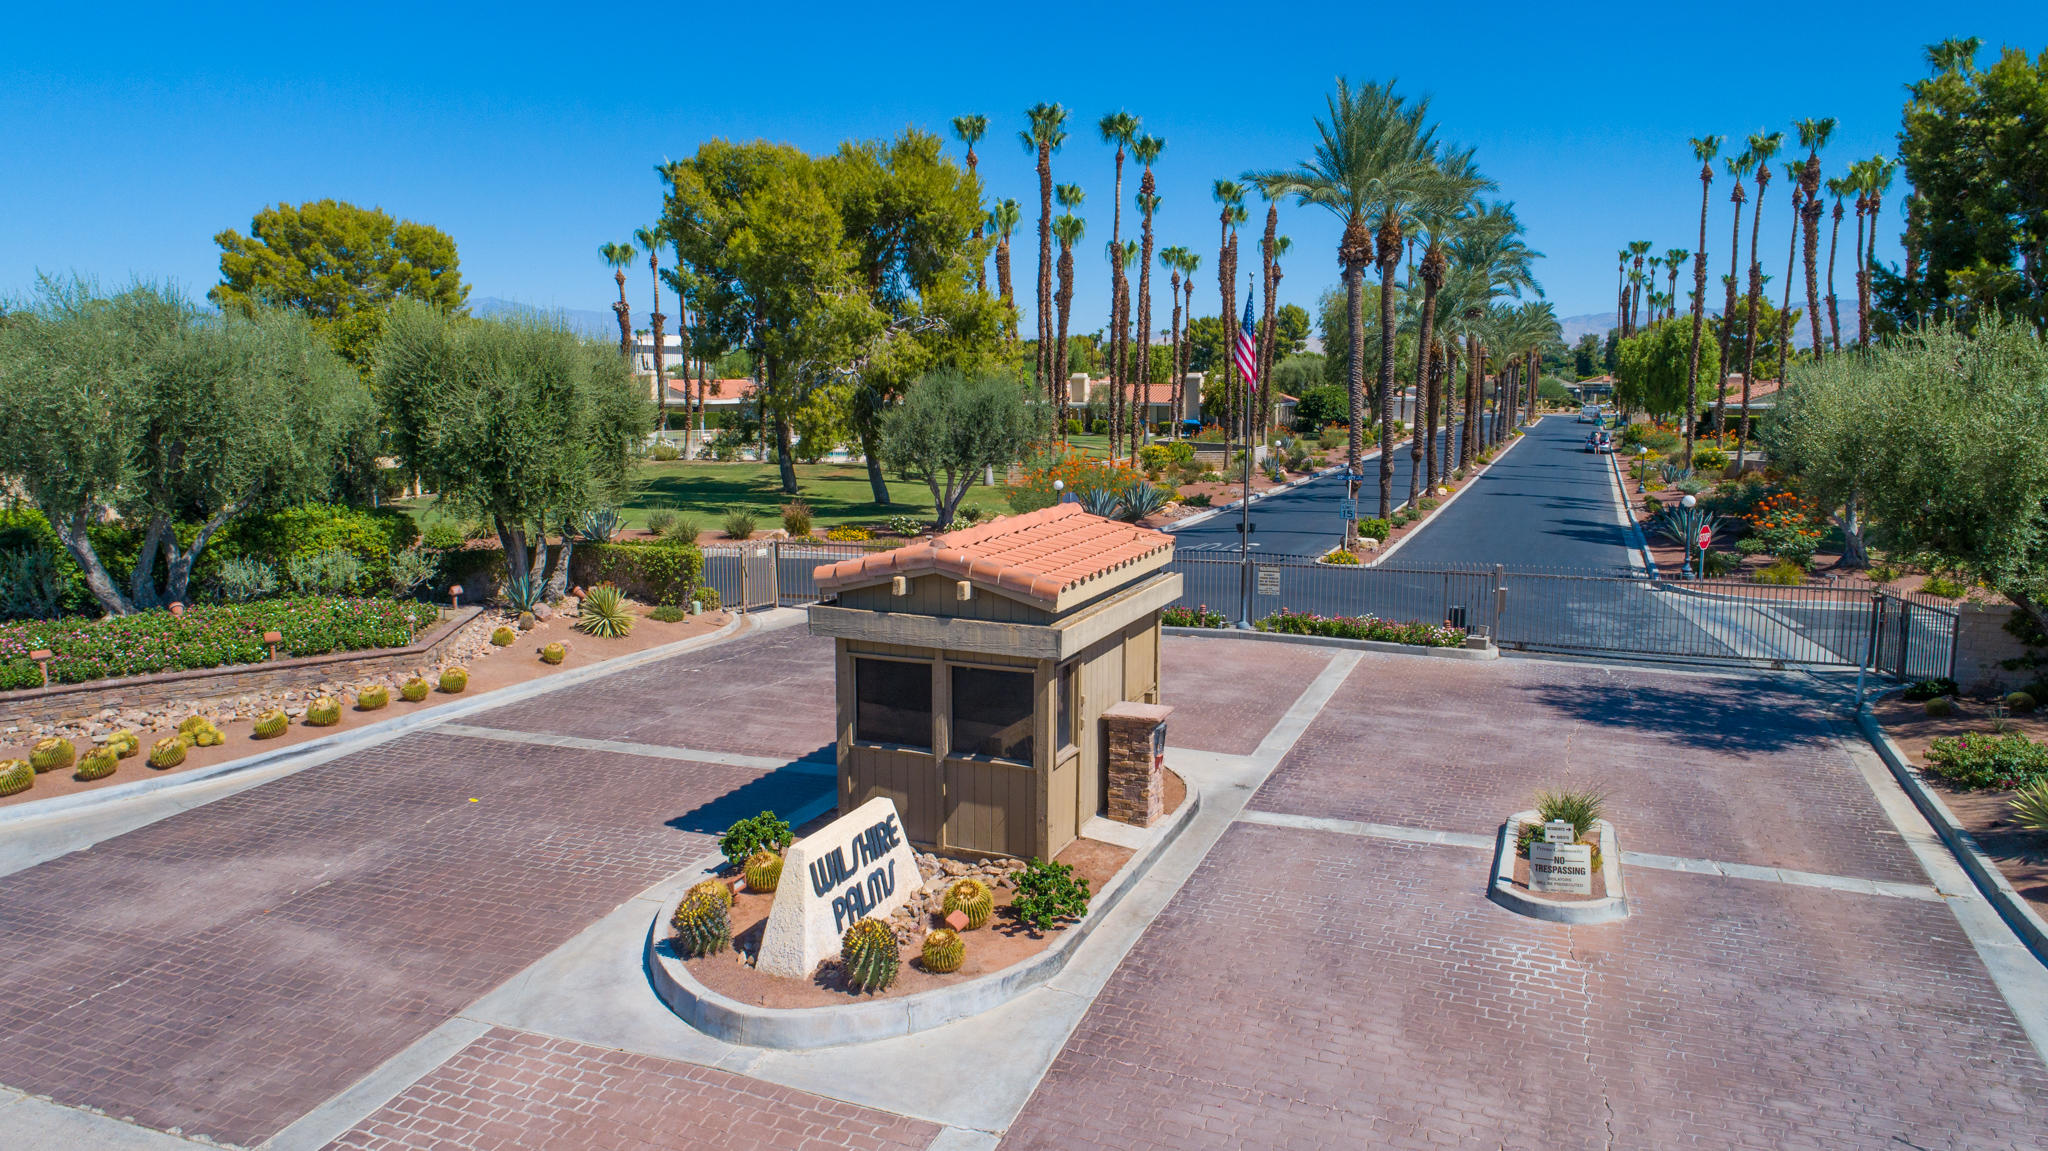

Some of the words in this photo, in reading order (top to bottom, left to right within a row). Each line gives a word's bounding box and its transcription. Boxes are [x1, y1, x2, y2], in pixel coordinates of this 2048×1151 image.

[1342, 510, 1353, 518] 15
[1699, 533, 1711, 542] STOP
[809, 813, 900, 898] WILSHIRE
[1553, 856, 1565, 864] NO
[1535, 863, 1586, 875] TRESPASSING
[832, 858, 895, 935] PALMS
